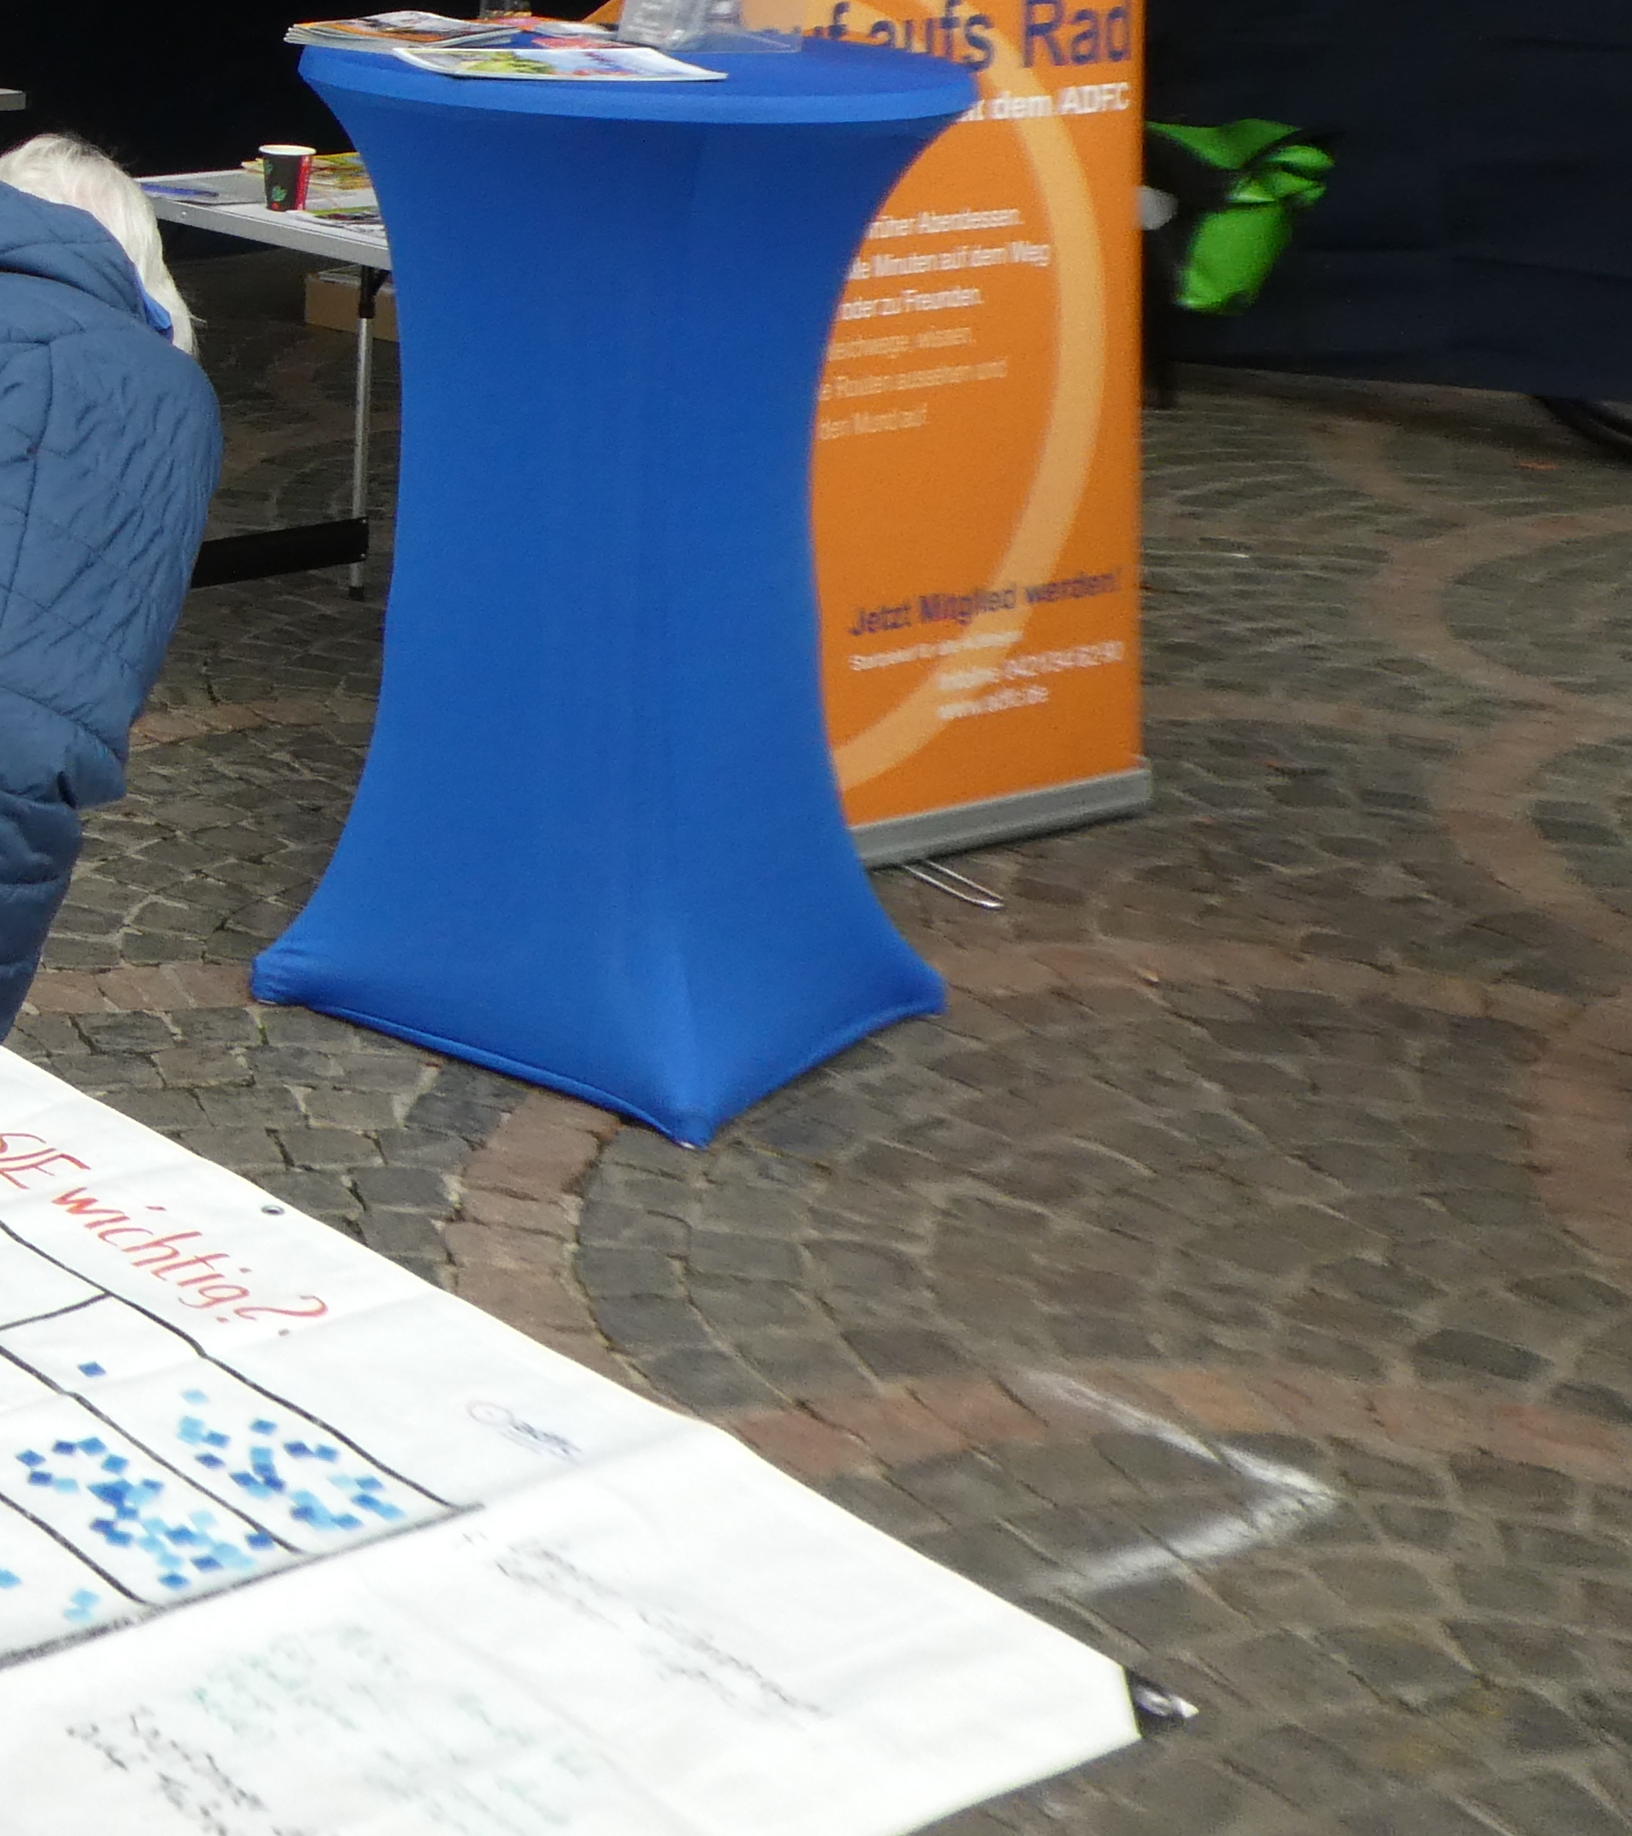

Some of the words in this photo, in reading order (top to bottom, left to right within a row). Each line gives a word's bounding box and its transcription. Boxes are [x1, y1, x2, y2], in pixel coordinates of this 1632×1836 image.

[990, 92, 1053, 121] dem
[1059, 81, 1130, 115] ADFC
[52, 1185, 329, 1324] wichtig?
